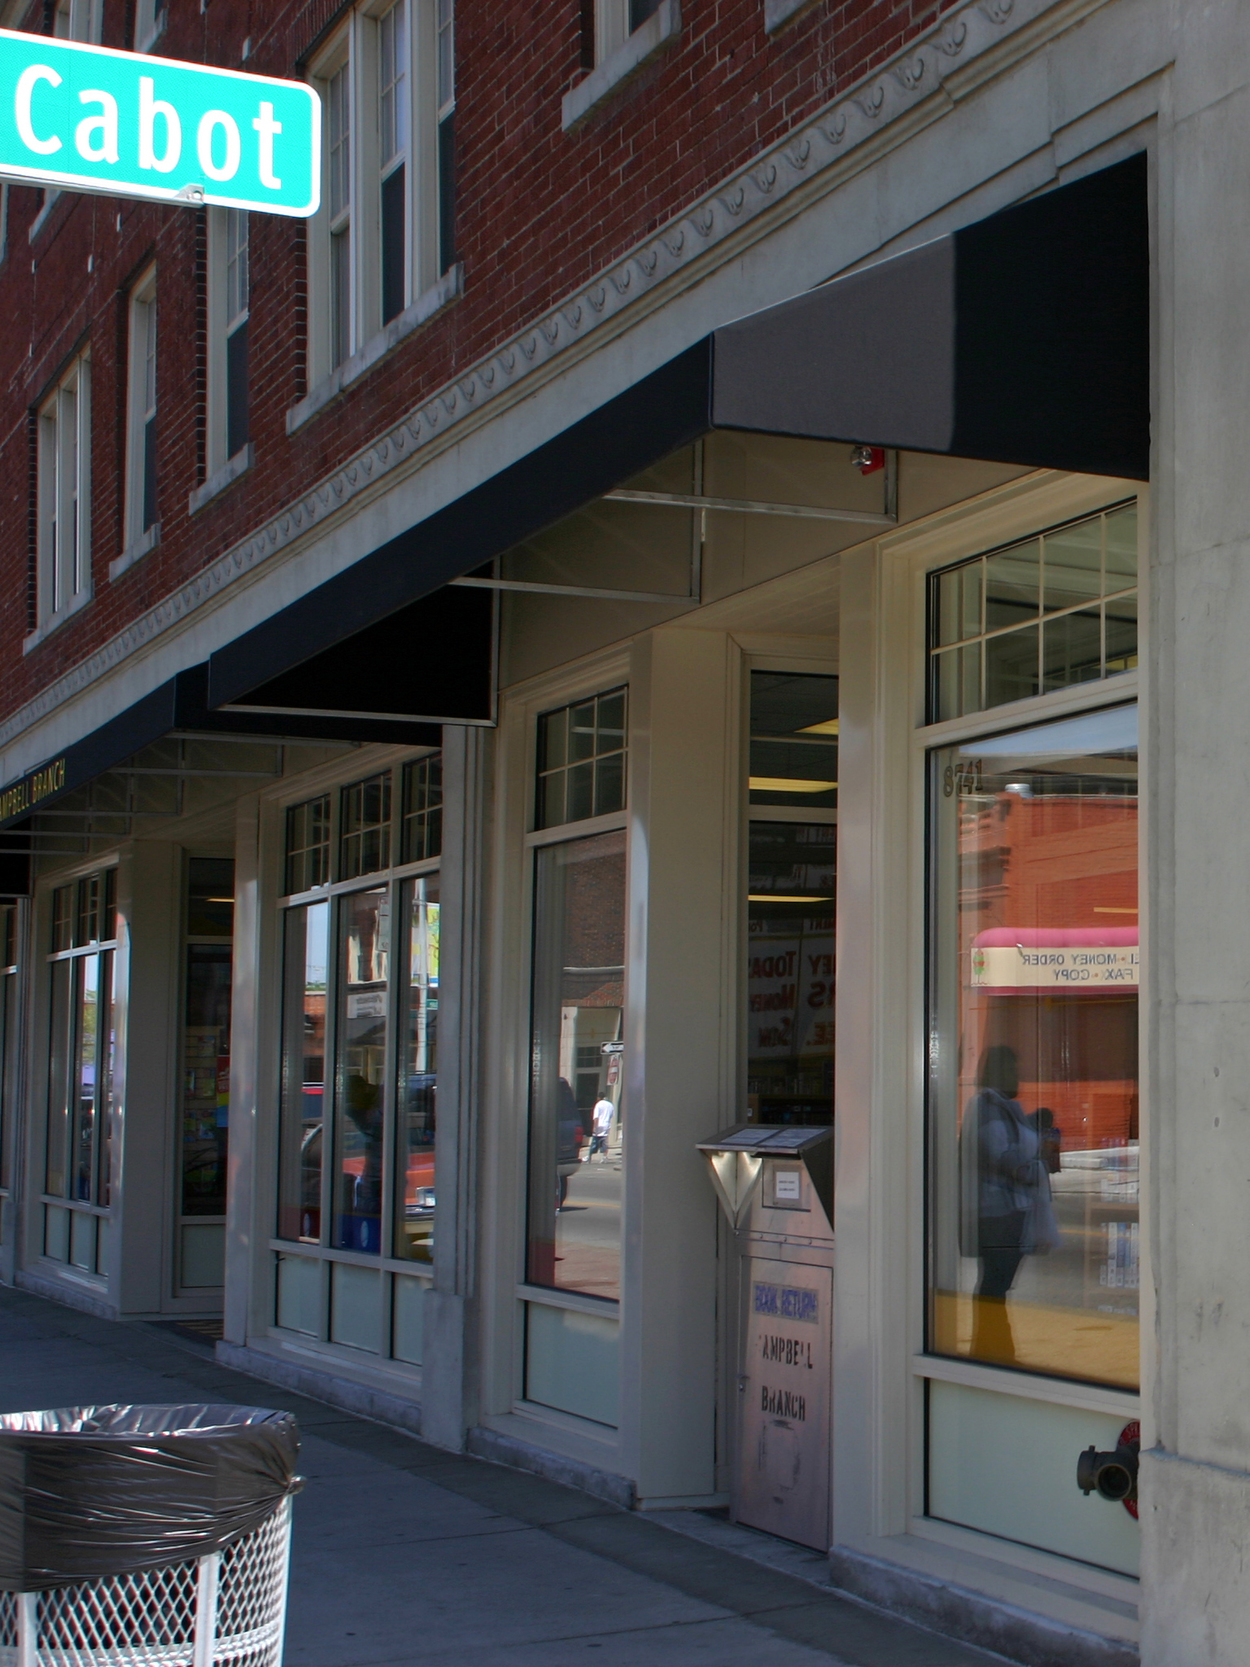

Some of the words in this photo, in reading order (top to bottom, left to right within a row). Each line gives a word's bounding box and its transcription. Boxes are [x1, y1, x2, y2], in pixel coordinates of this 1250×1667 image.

[14, 63, 283, 191] Cabot
[32, 757, 66, 804] BRANCH
[943, 758, 984, 798] 8741
[755, 1284, 778, 1314] BOOK
[761, 1385, 806, 1422] BRANCH
